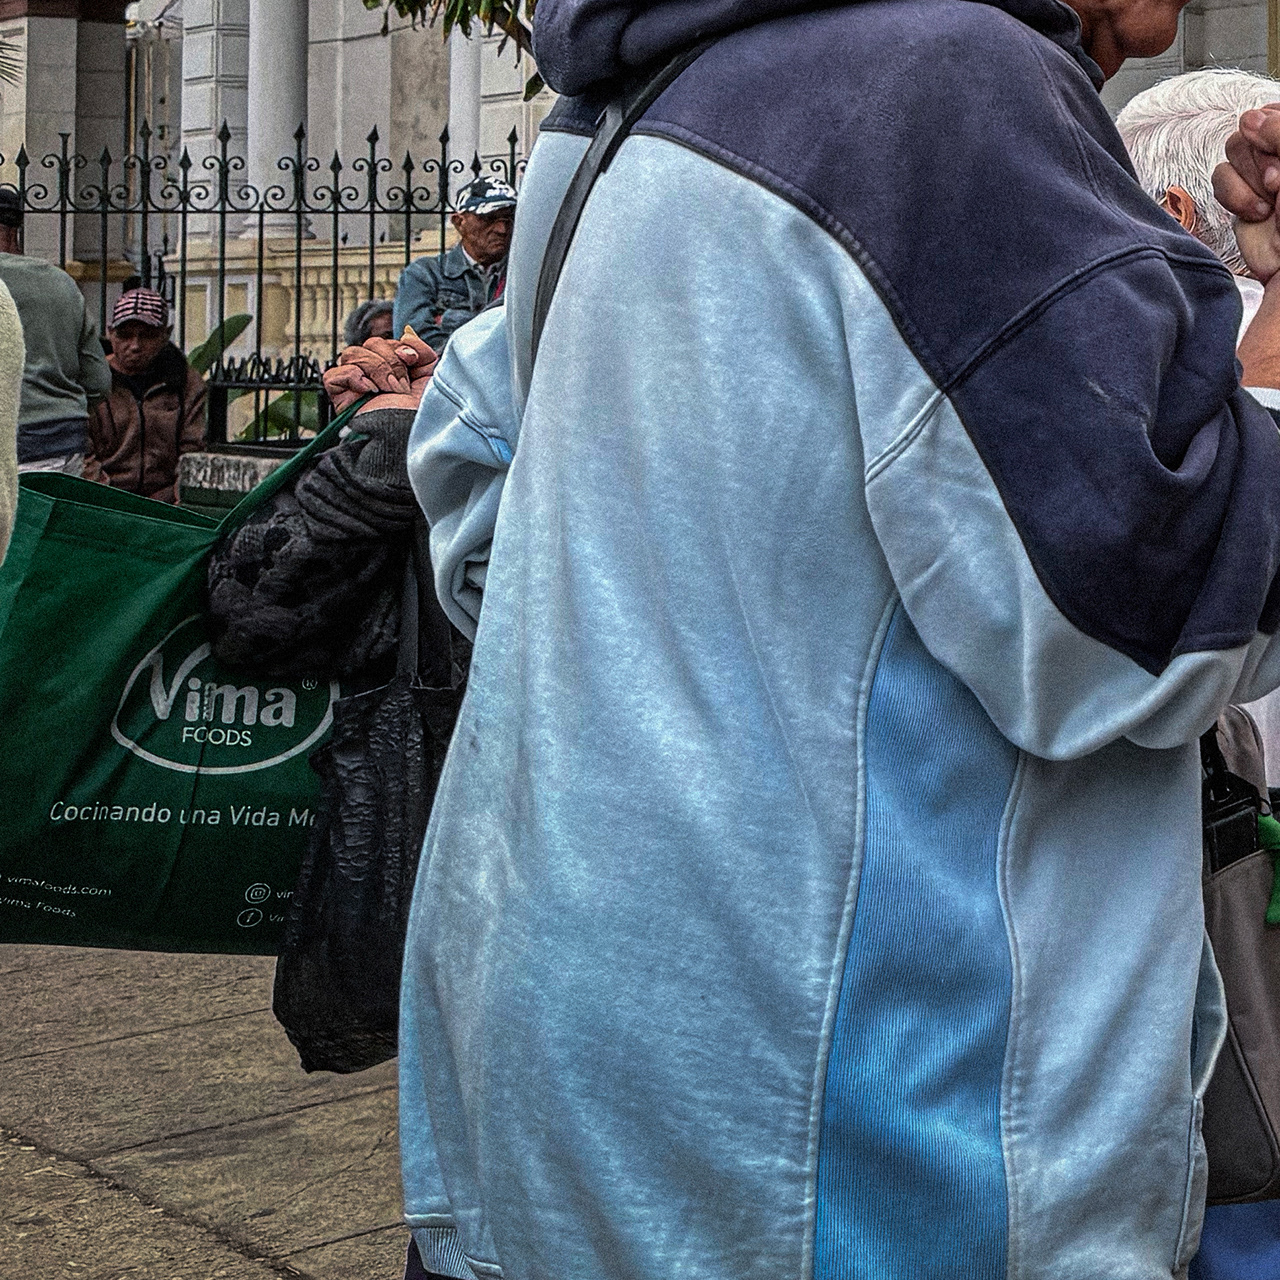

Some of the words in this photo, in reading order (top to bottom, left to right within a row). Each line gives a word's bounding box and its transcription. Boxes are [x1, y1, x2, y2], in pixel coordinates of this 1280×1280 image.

[150, 641, 297, 728] Vima
[182, 726, 252, 747] FOODS
[50, 801, 171, 823] Cocinando
[179, 809, 221, 825] una
[230, 805, 280, 826] Vida
